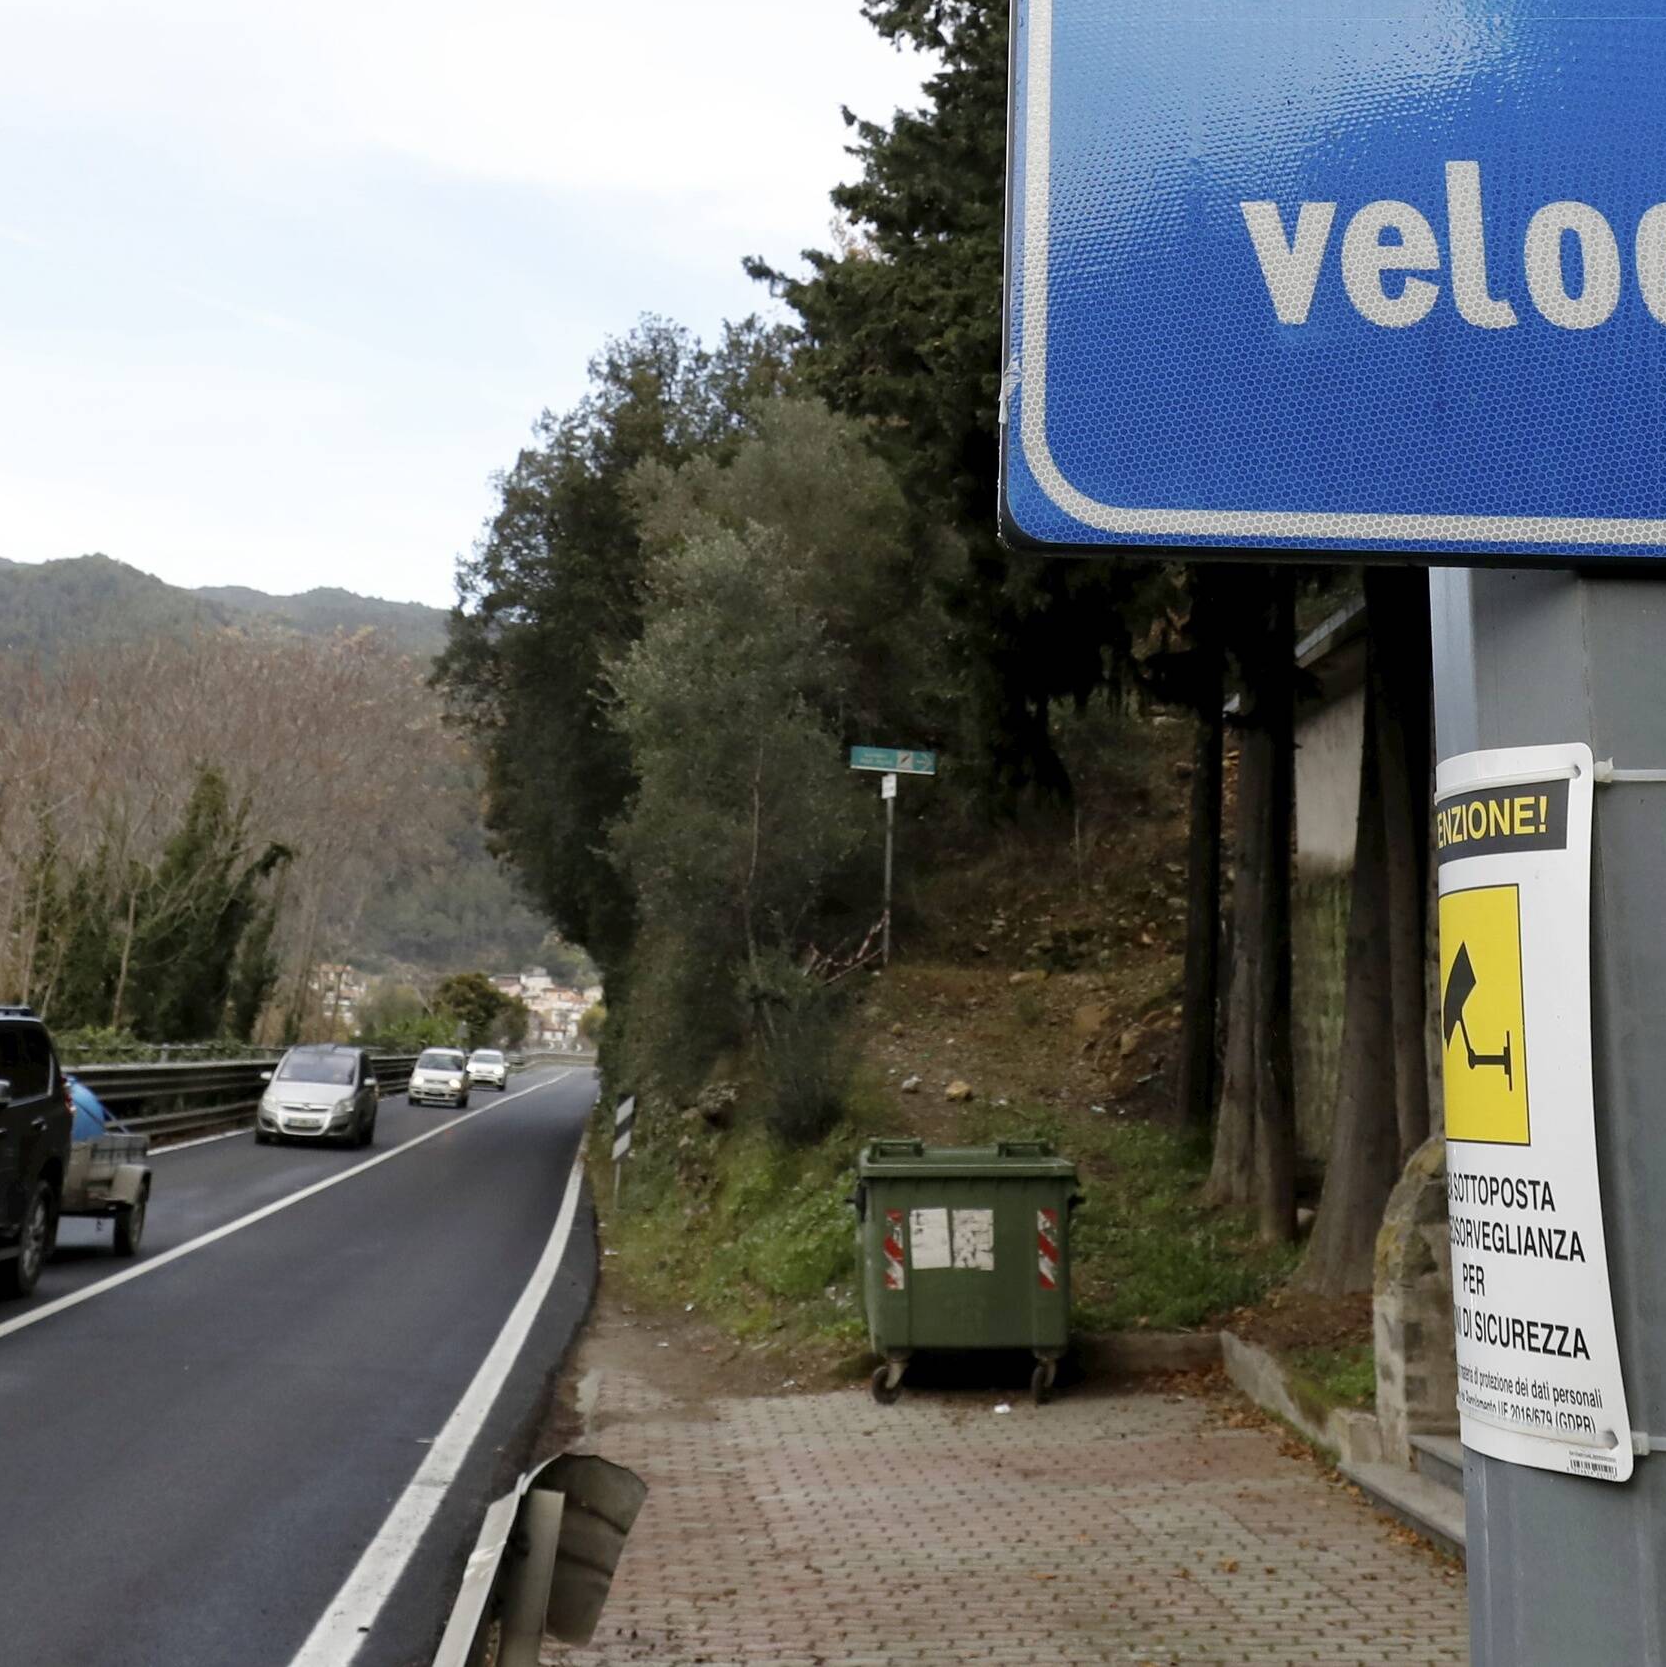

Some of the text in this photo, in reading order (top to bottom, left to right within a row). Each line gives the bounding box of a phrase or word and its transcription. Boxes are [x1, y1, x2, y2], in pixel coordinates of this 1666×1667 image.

[1454, 1172, 1556, 1212] SOTTOPOSTA
[1463, 1263, 1485, 1296] PER
[1463, 1308, 1472, 1340] DI
[1475, 1311, 1590, 1360] SICUREZZA
[1479, 1370, 1513, 1394] protezione
[1515, 1376, 1529, 1397] dei
[1531, 1379, 1550, 1401] dati
[1552, 1386, 1603, 1409] personali
